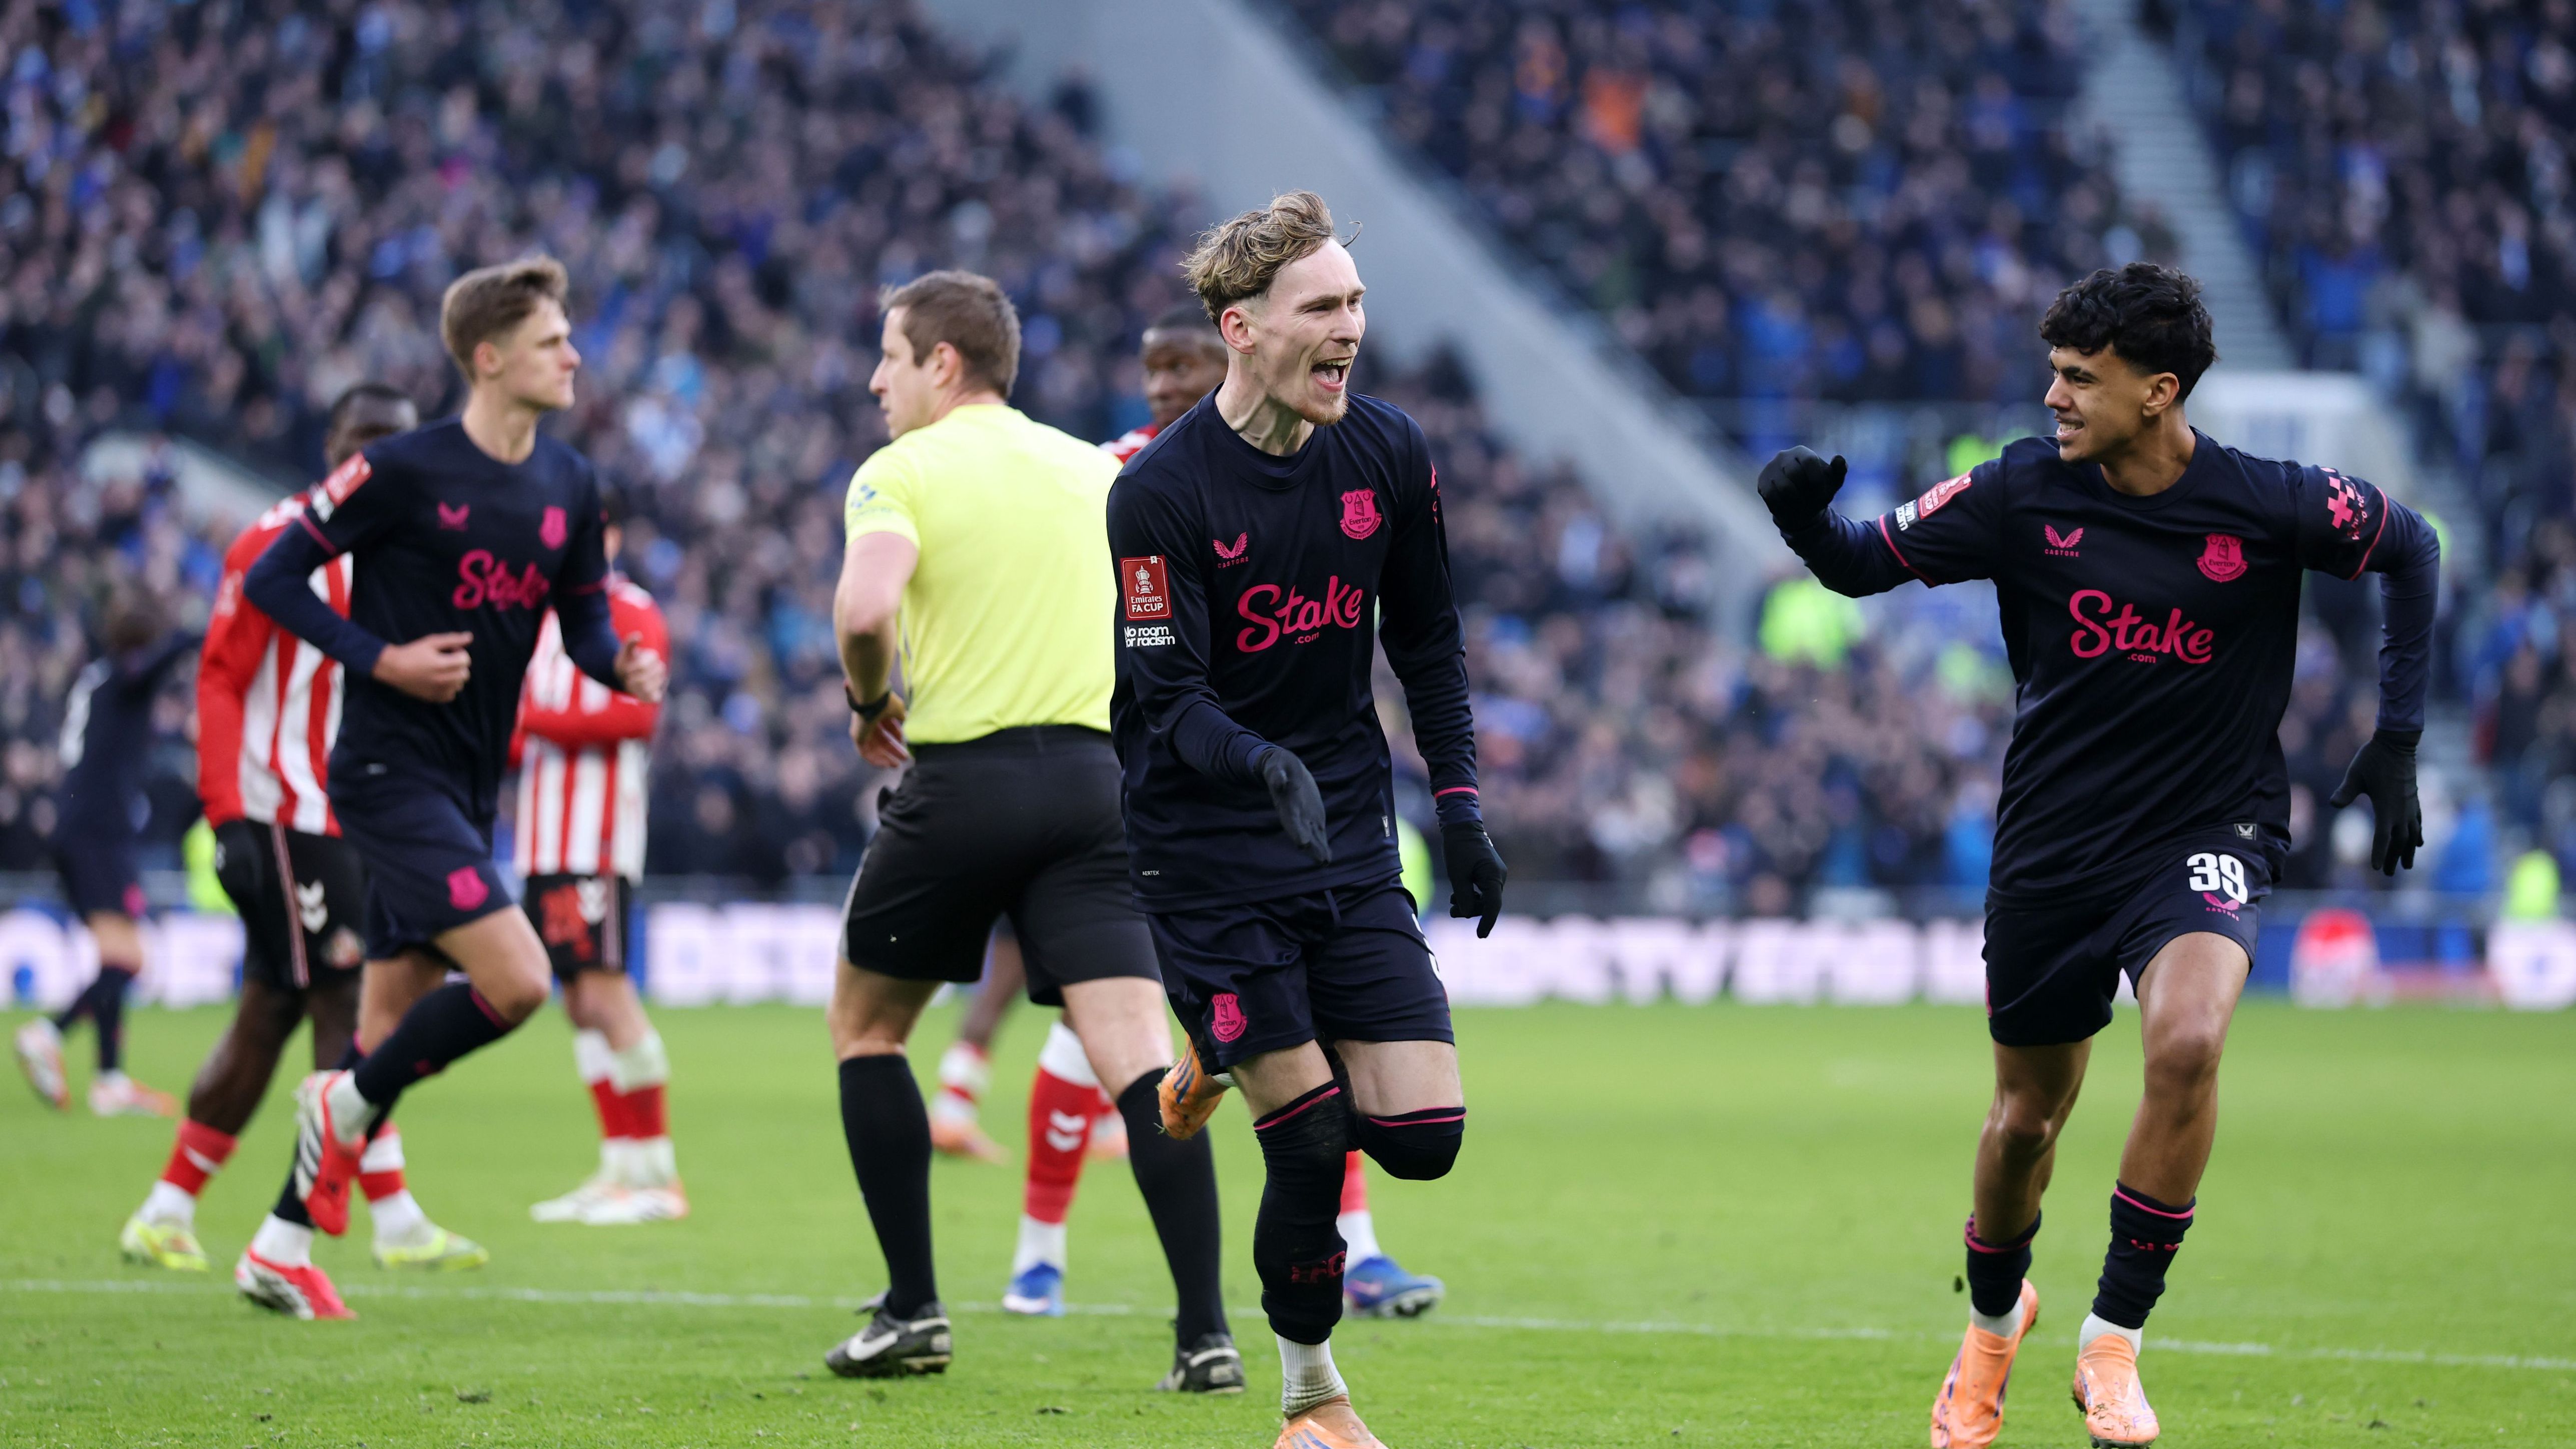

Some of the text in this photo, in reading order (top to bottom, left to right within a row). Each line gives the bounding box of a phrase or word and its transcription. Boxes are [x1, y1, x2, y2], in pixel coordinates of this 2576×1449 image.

[1349, 517, 1371, 525] Everton
[2045, 549, 2079, 557] CASTORE
[1218, 556, 1249, 568] CASTORE
[1131, 595, 1162, 604] Emirates
[1132, 603, 1164, 612] FA CUP
[1237, 575, 1363, 652] Stake
[1124, 626, 1169, 637] No room
[2069, 589, 2214, 664] Stake
[1137, 635, 1175, 646] racism
[1295, 632, 1319, 644] .com
[2128, 653, 2156, 663] .com
[2186, 853, 2248, 904] 39
